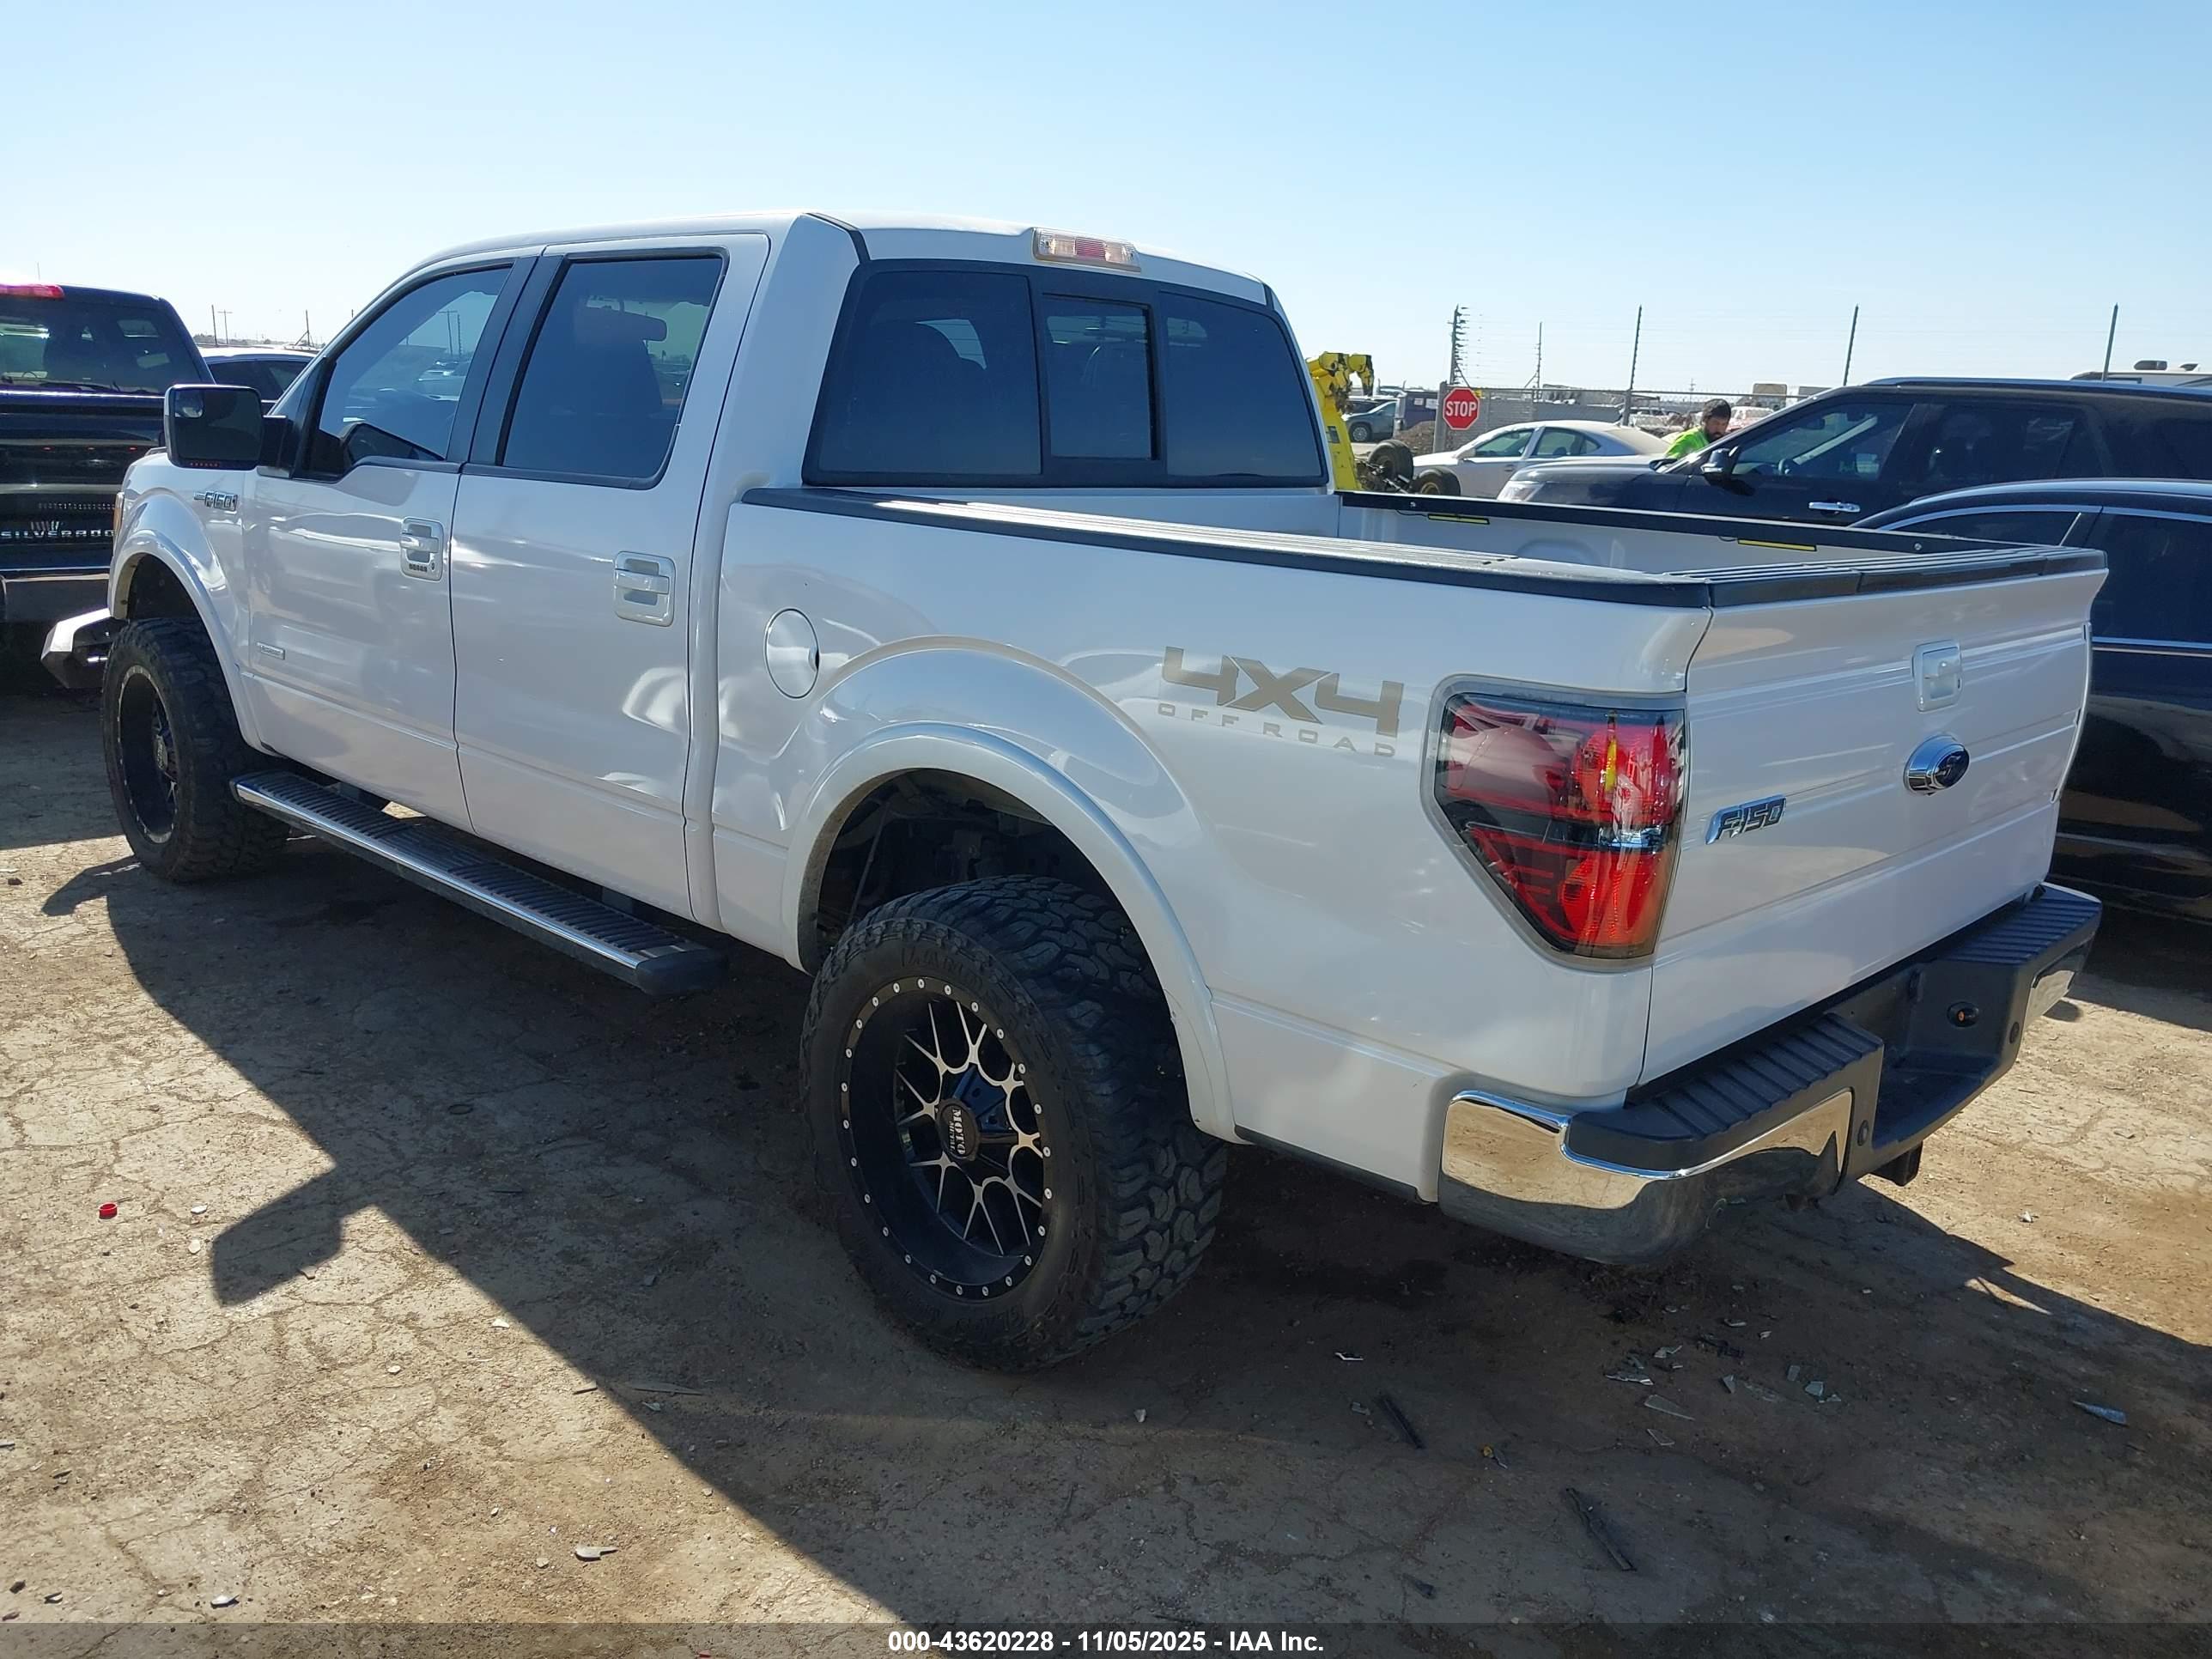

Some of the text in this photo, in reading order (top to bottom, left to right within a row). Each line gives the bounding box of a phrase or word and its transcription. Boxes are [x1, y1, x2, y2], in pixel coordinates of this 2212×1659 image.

[1446, 401, 1476, 416] STOP
[0, 529, 115, 538] SILVERADO
[1162, 646, 1403, 738] 4X4
[1158, 702, 1395, 758] OFF ROAD
[952, 1109, 966, 1155] MOTO
